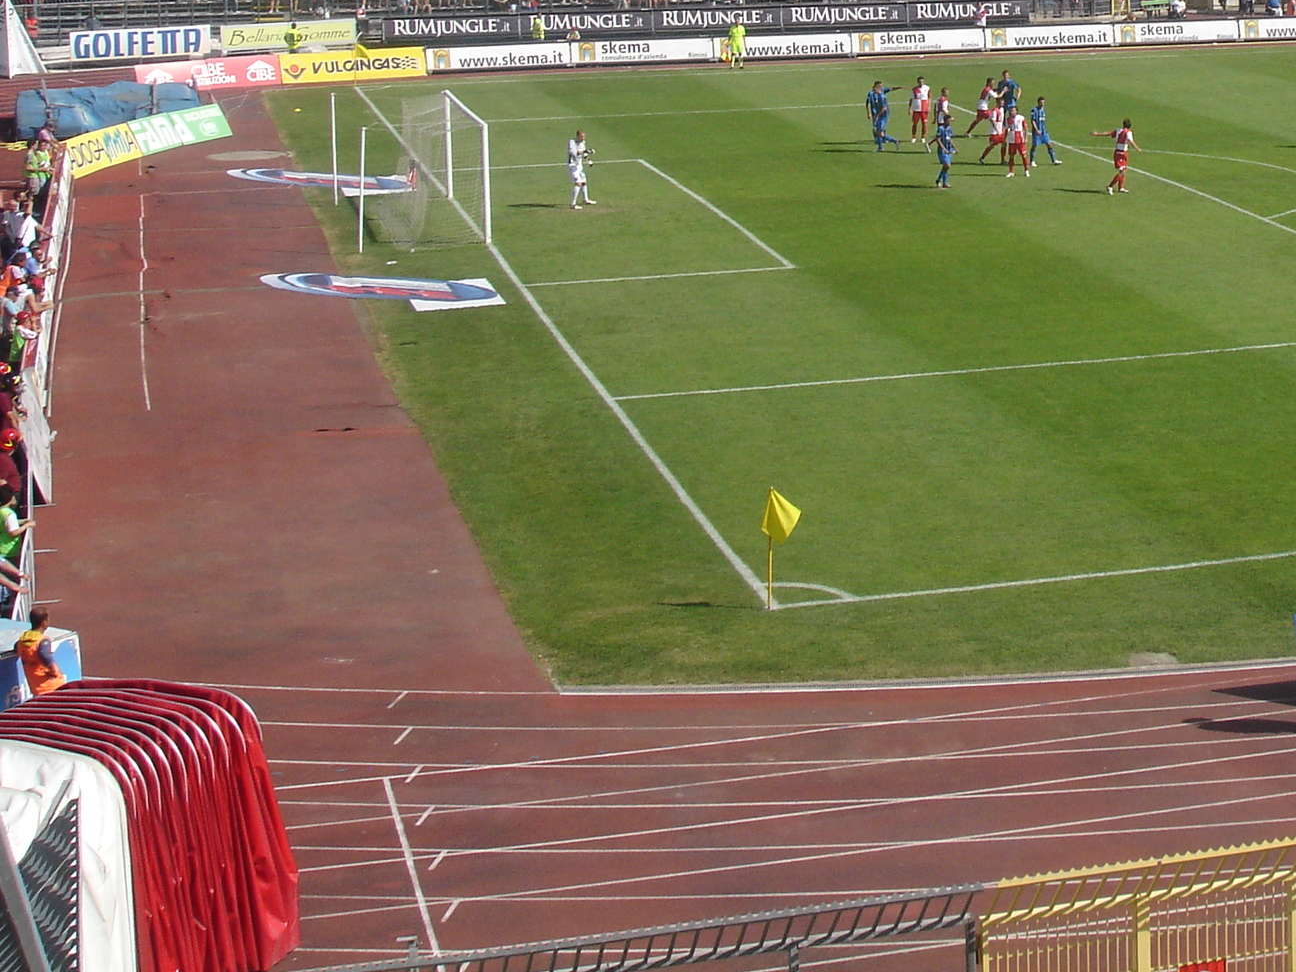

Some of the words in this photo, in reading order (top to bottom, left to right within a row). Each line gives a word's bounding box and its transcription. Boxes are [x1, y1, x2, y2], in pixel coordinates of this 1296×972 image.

[662, 9, 760, 26] RUMJUNGLE
[791, 5, 886, 23] RUMJUNGLE
[916, 2, 1007, 20] RUMJUNGLE
[393, 18, 497, 38] RUMJUNGLE
[1140, 24, 1183, 36] skema
[74, 28, 202, 59] GOLFETTA
[228, 28, 284, 46] Bellaria
[880, 31, 926, 45] skema
[1014, 31, 1108, 46] www.skema.it
[601, 41, 650, 55] skema
[745, 41, 846, 57] www.skema.it
[312, 57, 400, 74] VULCANGAS
[459, 51, 564, 68] www.skema.it
[246, 68, 276, 82] CIBE
